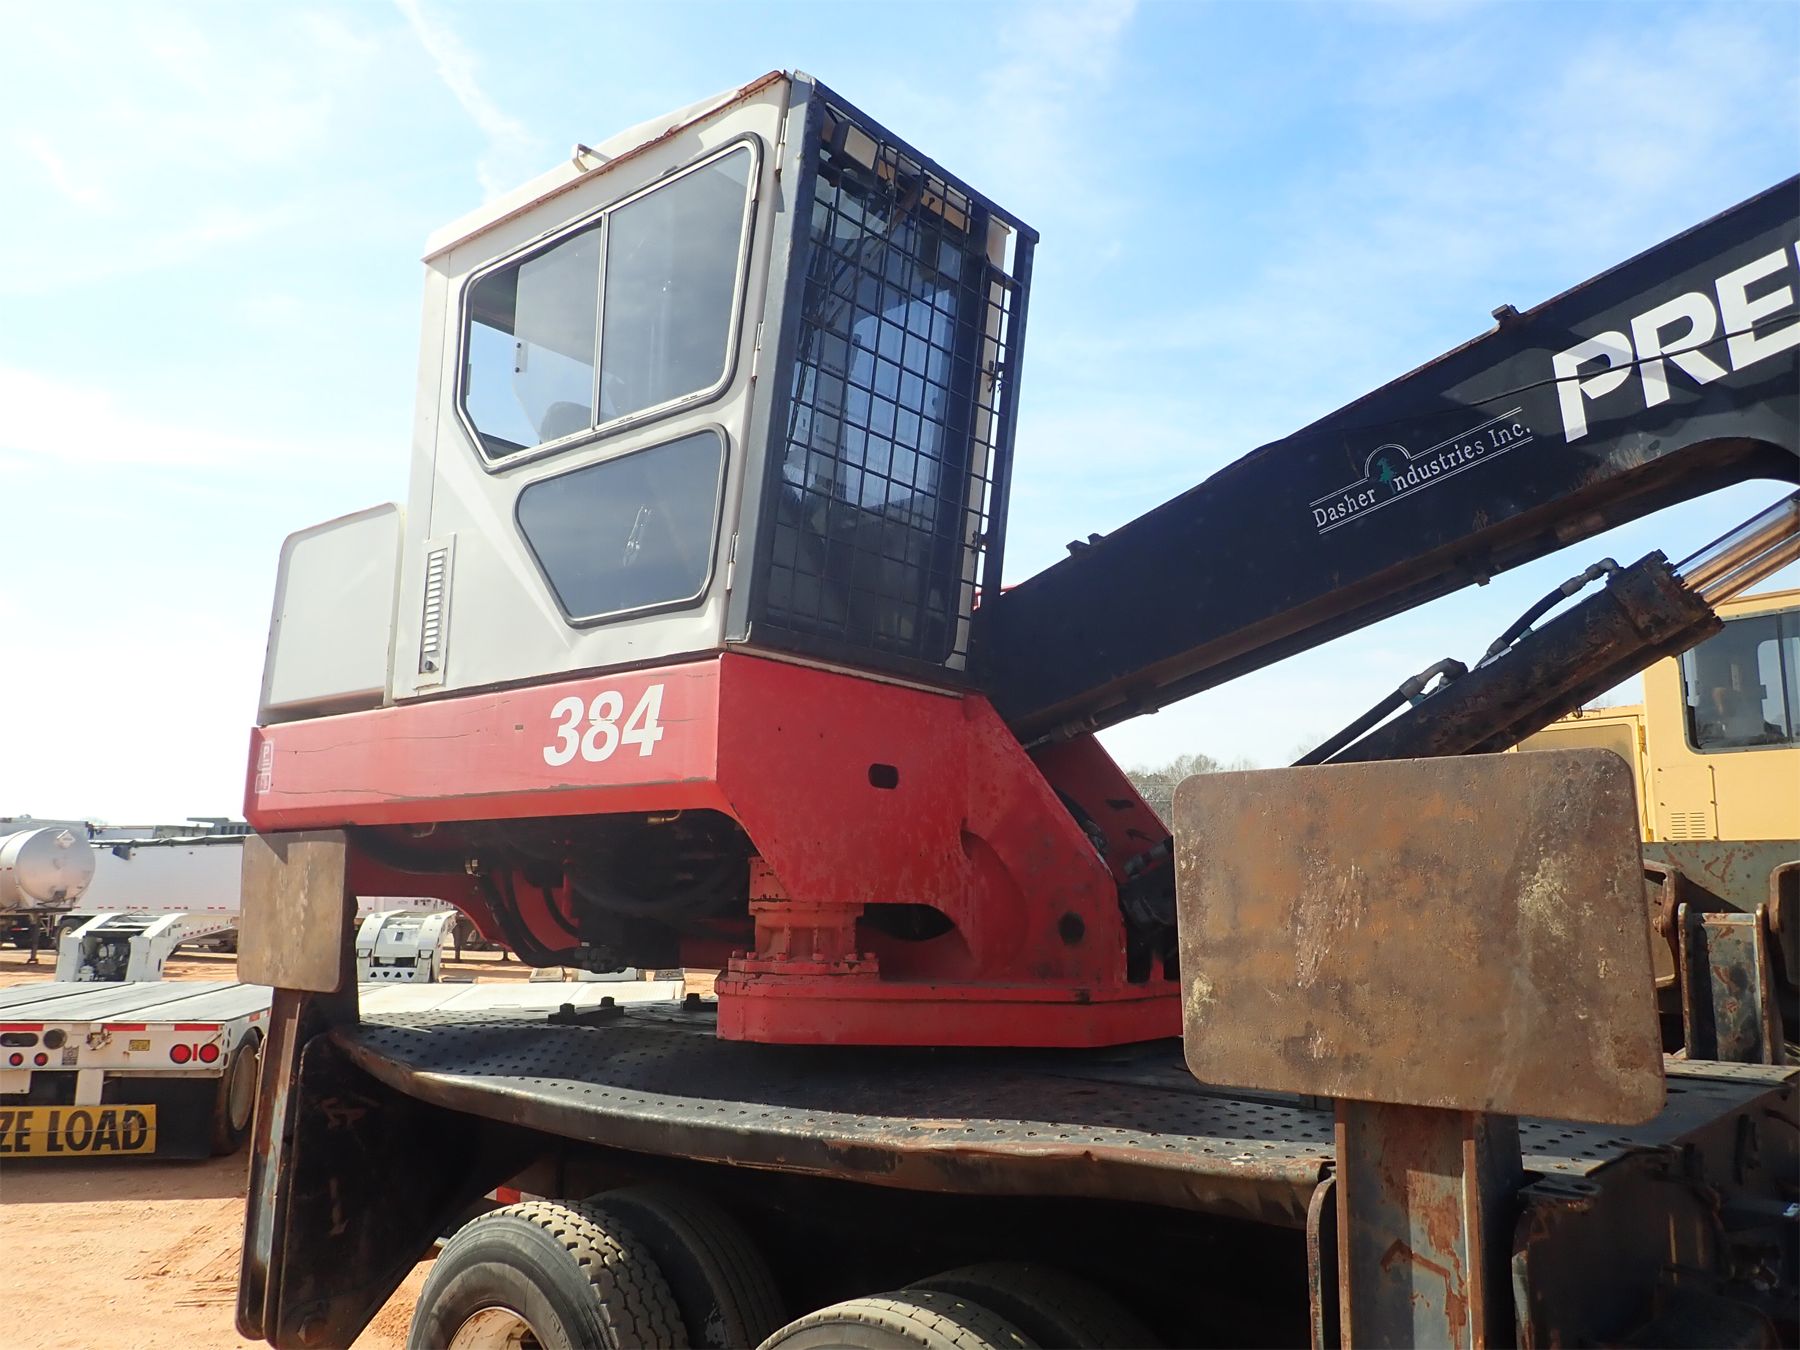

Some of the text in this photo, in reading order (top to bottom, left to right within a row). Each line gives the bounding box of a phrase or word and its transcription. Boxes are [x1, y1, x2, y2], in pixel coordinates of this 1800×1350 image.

[1552, 240, 1800, 443] PRE
[1312, 487, 1376, 528] Dasher
[1487, 422, 1531, 448] Inc.
[543, 684, 665, 767] 384
[46, 1110, 148, 1152] LOAD
